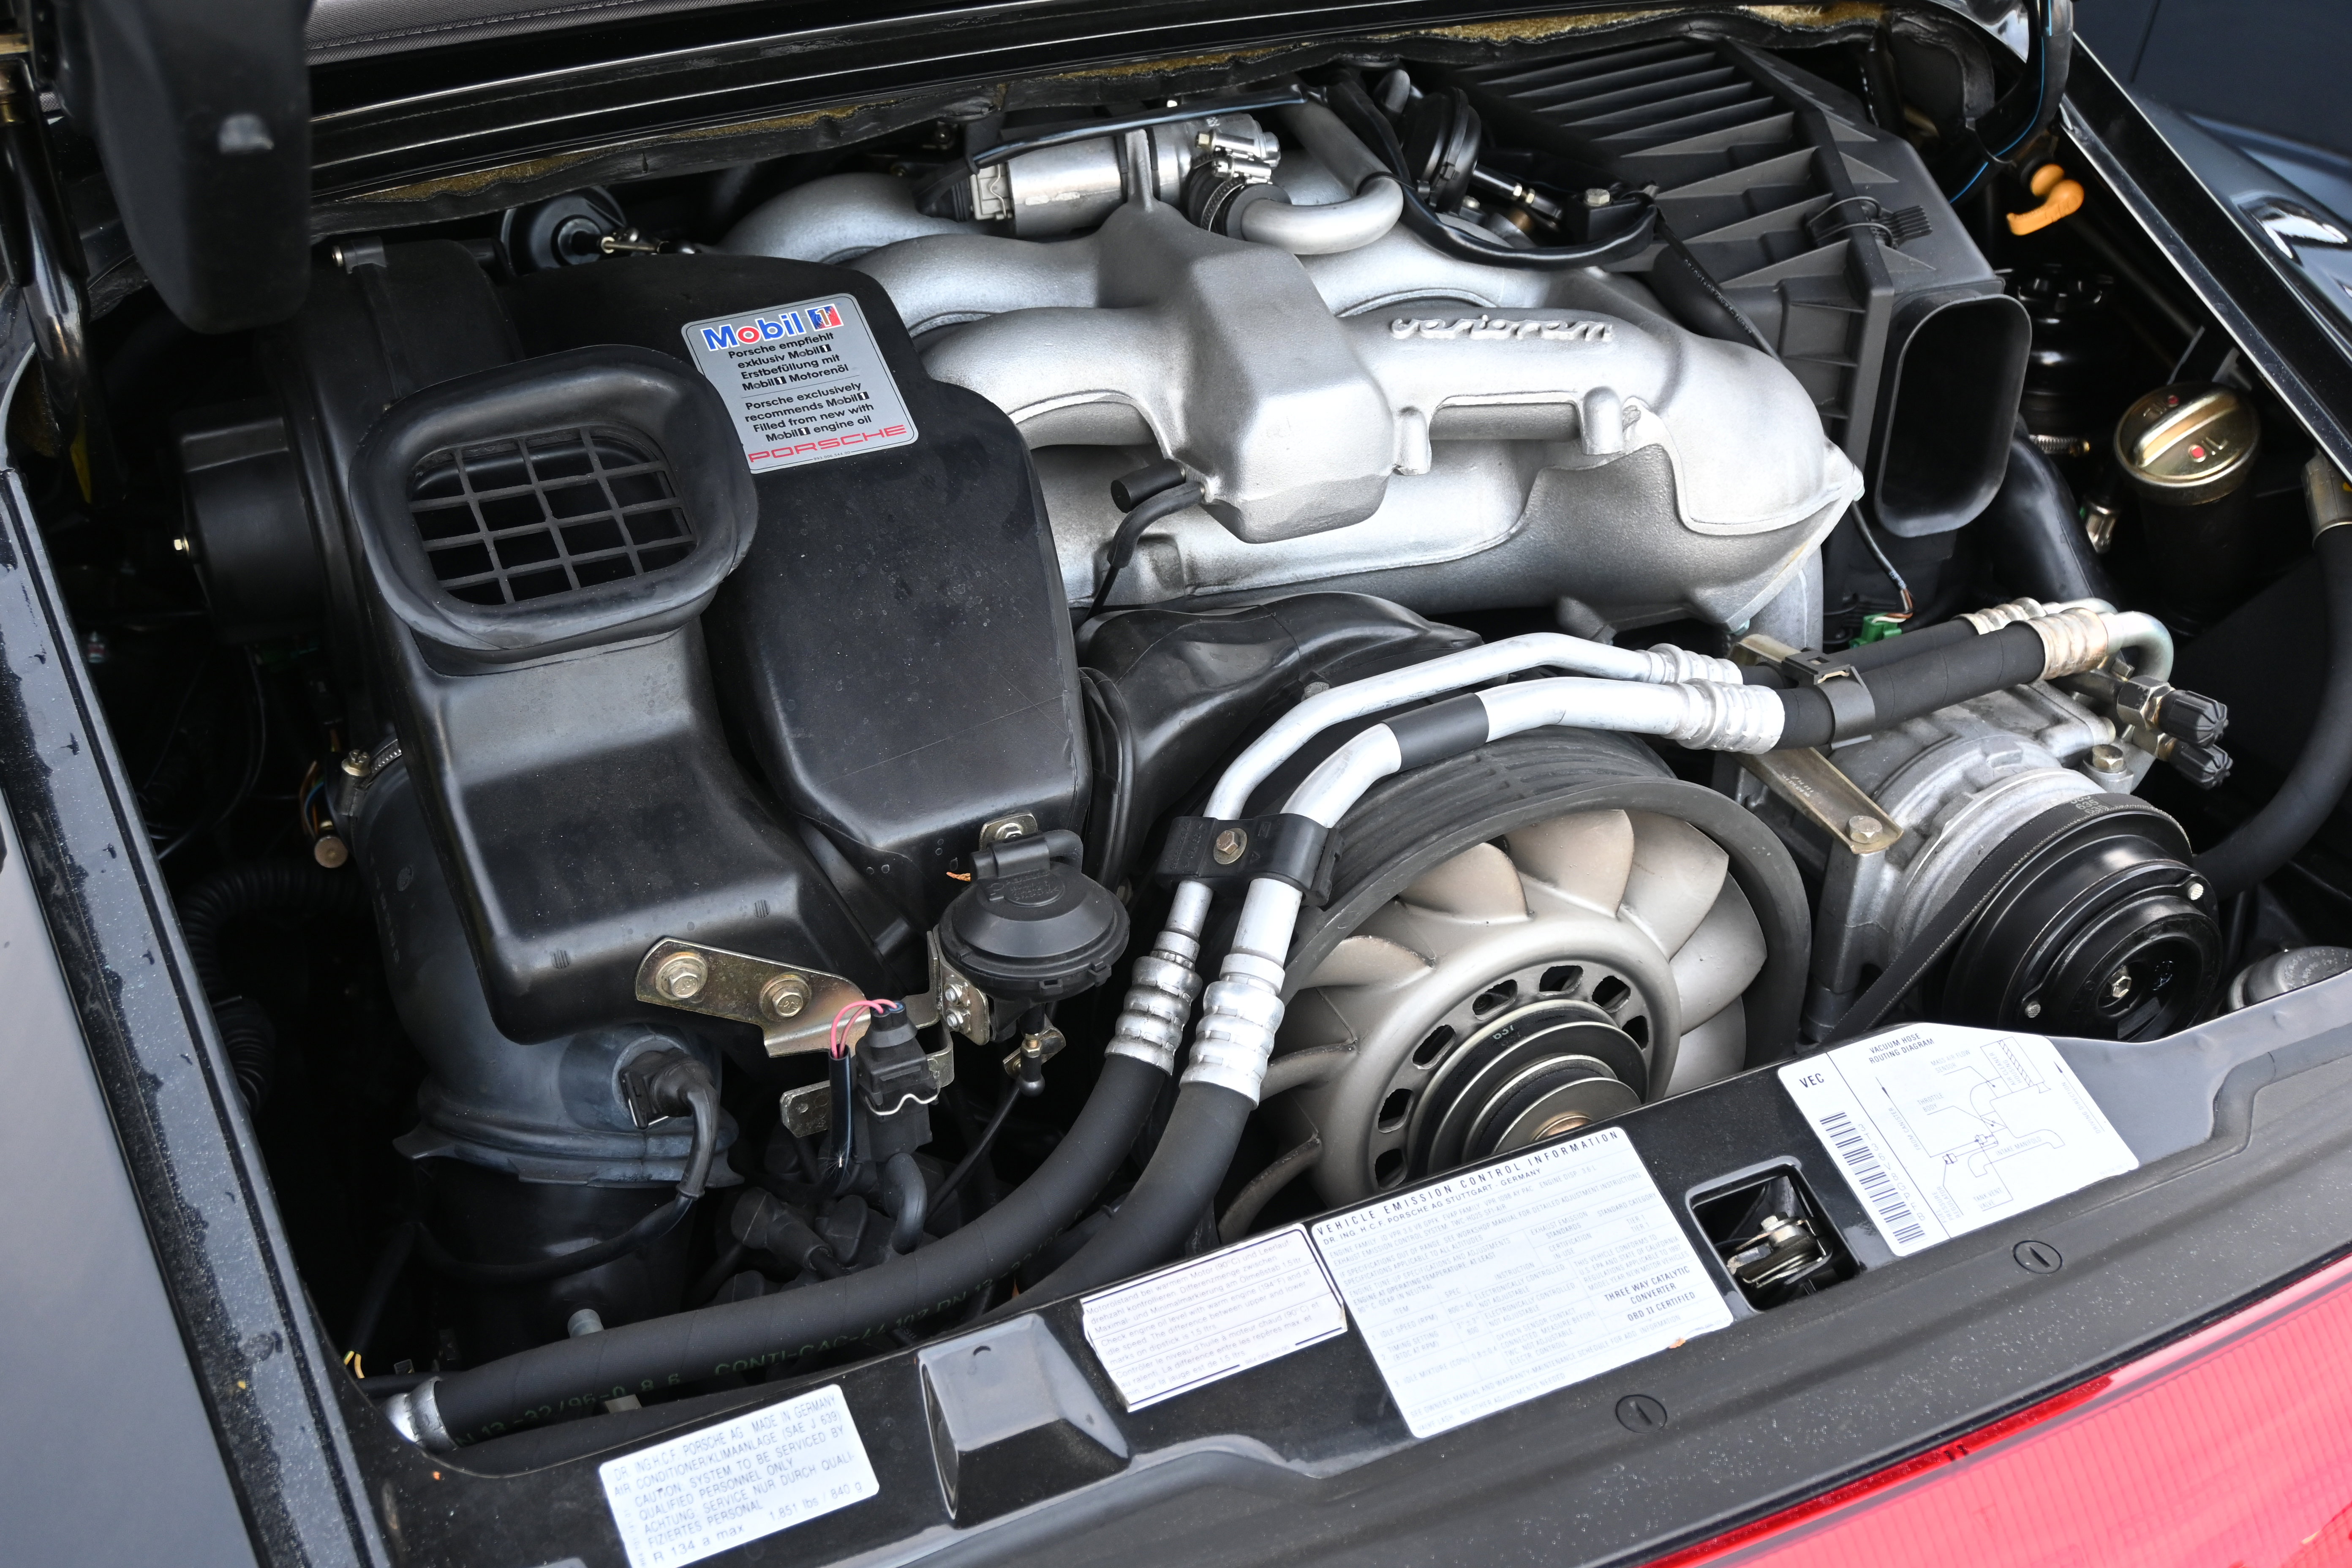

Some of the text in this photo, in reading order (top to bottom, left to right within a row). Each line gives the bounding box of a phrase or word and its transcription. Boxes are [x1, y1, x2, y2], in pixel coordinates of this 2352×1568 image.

[700, 311, 806, 351] Mobil
[727, 332, 833, 359] Porsche empfiehlt
[737, 354, 784, 368] exklusiv
[740, 354, 840, 379] Erstbefüllung mit
[788, 364, 849, 382] Motorenöl
[745, 382, 860, 410] Porsche exclusively
[744, 402, 823, 422] recommends
[753, 403, 874, 432] Filled from new with
[813, 420, 854, 433] engine
[857, 415, 871, 424] oil
[747, 424, 906, 463] PORSCHE
[2075, 799, 2099, 810] 635
[1868, 1037, 1935, 1064] ROUTING DIAGRAM
[1869, 1032, 1921, 1054] VACUUM HOSE
[1930, 1057, 1946, 1066] MASS
[1955, 1049, 1970, 1058] FLOW
[1935, 1062, 1957, 1073] SENSOR
[1989, 1052, 2017, 1086] AIR CLEANER
[1798, 1072, 1825, 1088] VEC
[2002, 1059, 2023, 1083] HOUSING
[1916, 1092, 1944, 1105] THROTTLE
[1922, 1102, 1937, 1113] BODY
[2061, 1081, 2101, 1134] DRIVING DIRECTION
[1887, 1107, 1921, 1151] FROM CANISTER
[1995, 1135, 2042, 1156] INTAKE MANIFOLD
[1316, 1130, 1618, 1236] VEHICLE EMISSION CONTROL INFORMATION
[1386, 1205, 1429, 1224] PORSCHE
[1431, 1200, 1443, 1210] AG
[1445, 1184, 1493, 1205] STUTTGART
[1500, 1168, 1541, 1186] GERMANY
[1597, 1192, 1657, 1217] STANDARD CATEGORY
[1931, 1191, 1954, 1221] PRESSURE
[1936, 1185, 1961, 1218] REGULATOR
[1973, 1193, 1988, 1201] TANK
[1979, 1199, 1995, 1209] VALVE
[1530, 1211, 1588, 1235] EXHAUST EMISSION
[1625, 1216, 1641, 1225] TIER
[1630, 1223, 1645, 1233] TIER
[1936, 1209, 1947, 1223] FUEL
[1545, 1222, 1582, 1239] STANDARDS
[1548, 1232, 1592, 1252] CERTIFICATION
[1343, 1265, 1392, 1287] SPECIFICATIONS
[1393, 1252, 1429, 1270] APPLICABLE
[1438, 1245, 1451, 1255] ALL
[1451, 1234, 1484, 1250] ALTITUDES
[1553, 1247, 1576, 1260] IN-USE
[1086, 1292, 1139, 1315] Motorölstand
[1140, 1288, 1153, 1297] bei
[1155, 1276, 1189, 1291] warmem
[1190, 1267, 1212, 1279] Motor
[1242, 1250, 1257, 1261] und
[1494, 1261, 1535, 1280] INSTRUCTION
[1444, 1287, 1461, 1298] SPEC
[1603, 1266, 1690, 1302] THREE WAY CATALYTIC
[1630, 1282, 1677, 1304] CONVERTER
[1101, 1333, 1127, 1347] Check
[1129, 1324, 1156, 1337] engine
[1157, 1318, 1167, 1327] oil
[1168, 1311, 1187, 1323] level
[1188, 1306, 1205, 1316] with
[1206, 1298, 1228, 1309] warm
[1230, 1288, 1256, 1301] engine
[1287, 1271, 1301, 1282] and
[1392, 1304, 1410, 1316] ITEM
[1626, 1309, 1645, 1321] OBD
[1655, 1291, 1696, 1311] CERTIFIED
[682, 1432, 727, 1456] PORSCHE
[730, 1426, 743, 1440] AG
[750, 1414, 777, 1432] MADE
[793, 1394, 834, 1418] GERMANY
[612, 1482, 632, 1498] AIR
[781, 1421, 806, 1440] (SAE
[819, 1409, 842, 1426] 639)
[689, 1464, 732, 1488] SYSTEM
[736, 1458, 751, 1470] TO
[755, 1451, 770, 1465] BE
[775, 1431, 825, 1458] SERVICED
[830, 1424, 842, 1438] BY
[639, 1457, 792, 1521] QUALIFIED PERSONNEL ONLY
[702, 1489, 749, 1514] SERVICE
[752, 1478, 776, 1494] NUR
[779, 1464, 816, 1486] DURCH
[802, 1495, 819, 1510] lbs
[829, 1484, 851, 1500] 840
[647, 1520, 702, 1546] FIZIERTES
[706, 1500, 763, 1526] PERSONAL
[671, 1539, 695, 1554] 134
[716, 1524, 743, 1540] max
